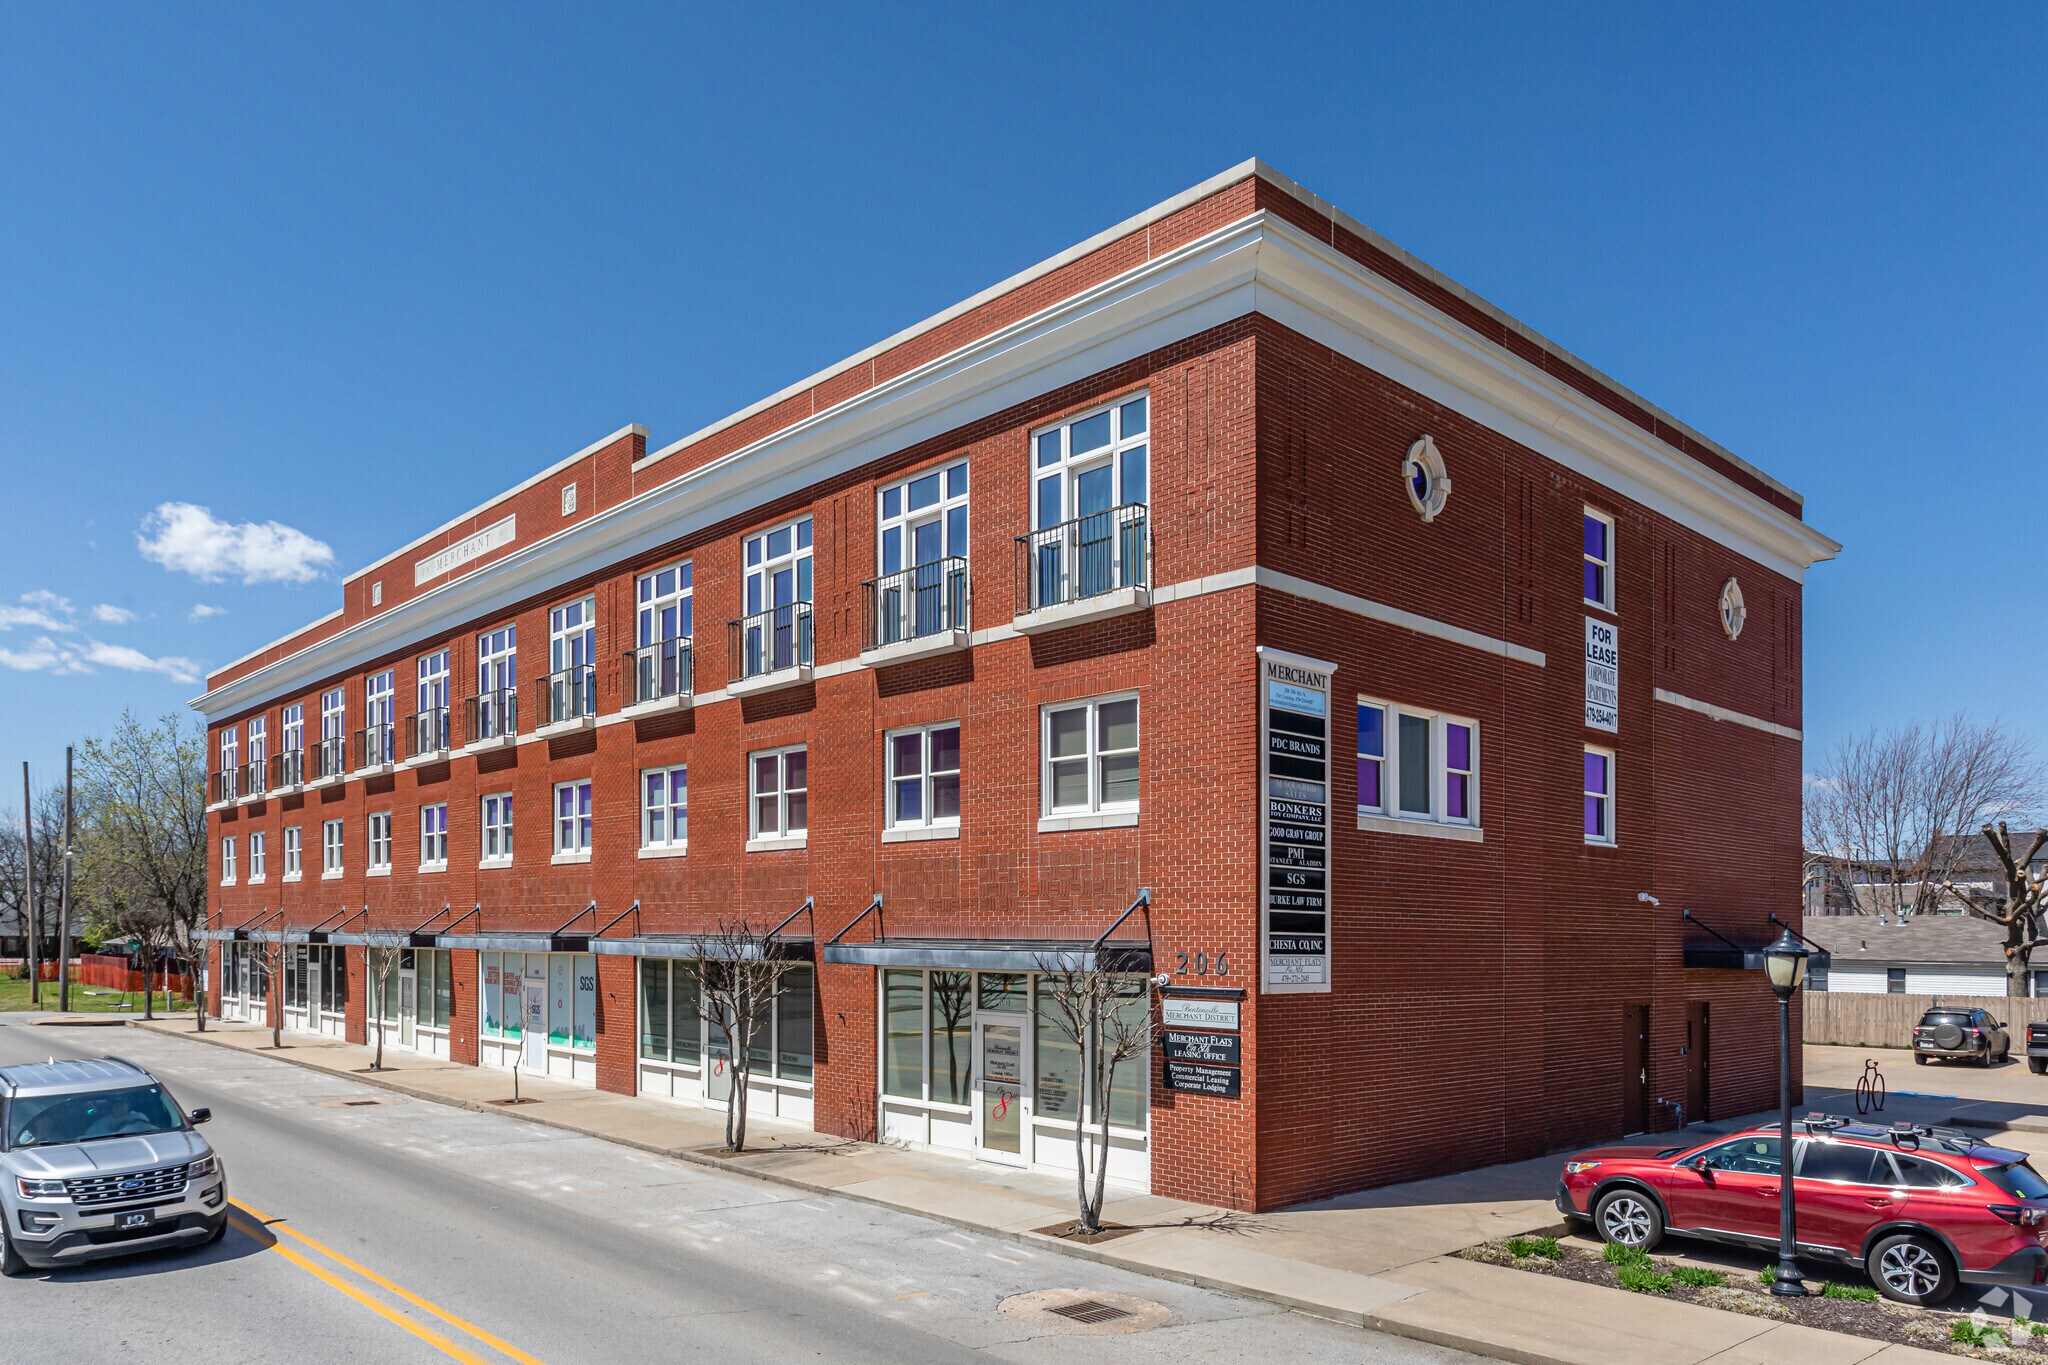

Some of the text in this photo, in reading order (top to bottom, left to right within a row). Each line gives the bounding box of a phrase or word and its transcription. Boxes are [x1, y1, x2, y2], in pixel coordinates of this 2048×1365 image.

[437, 534, 490, 570] MERCHANT
[1592, 625, 1611, 645] FOR
[1587, 643, 1616, 665] LEASE
[1267, 663, 1327, 688] MERCHANT
[1587, 664, 1616, 686] CORPORATE
[1587, 684, 1616, 706] APARTMENTS
[1271, 737, 1321, 755] PDC BRANDS
[1284, 781, 1316, 792] SQUARED
[1286, 790, 1307, 799] SALES
[1270, 802, 1322, 817] BONKERS
[1269, 826, 1323, 842] GOOD GRAVY GROUP
[1287, 847, 1304, 860] PMI
[1269, 857, 1322, 867] STANLEY ALADDIN
[1286, 873, 1306, 885] SGS
[1269, 894, 1322, 907] BURKE LAW FIRM
[1269, 939, 1297, 950] CHESTA
[1176, 952, 1228, 976] 206
[1270, 958, 1322, 966] MERCHANT FLATS
[580, 976, 594, 991] SGS
[532, 1004, 540, 1014] SGS
[1181, 1004, 1219, 1014] Bentonville
[1166, 1012, 1235, 1022] MERCHANT DISTRICT
[1168, 1033, 1232, 1046] MERCHANT FLATS
[750, 1050, 769, 1059] EETING
[1174, 1050, 1226, 1060] LEASING OFFICE
[1170, 1064, 1232, 1077] Property Management
[1172, 1073, 1229, 1085] Commercial Leasing
[1174, 1080, 1226, 1093] Corporate Lodging
